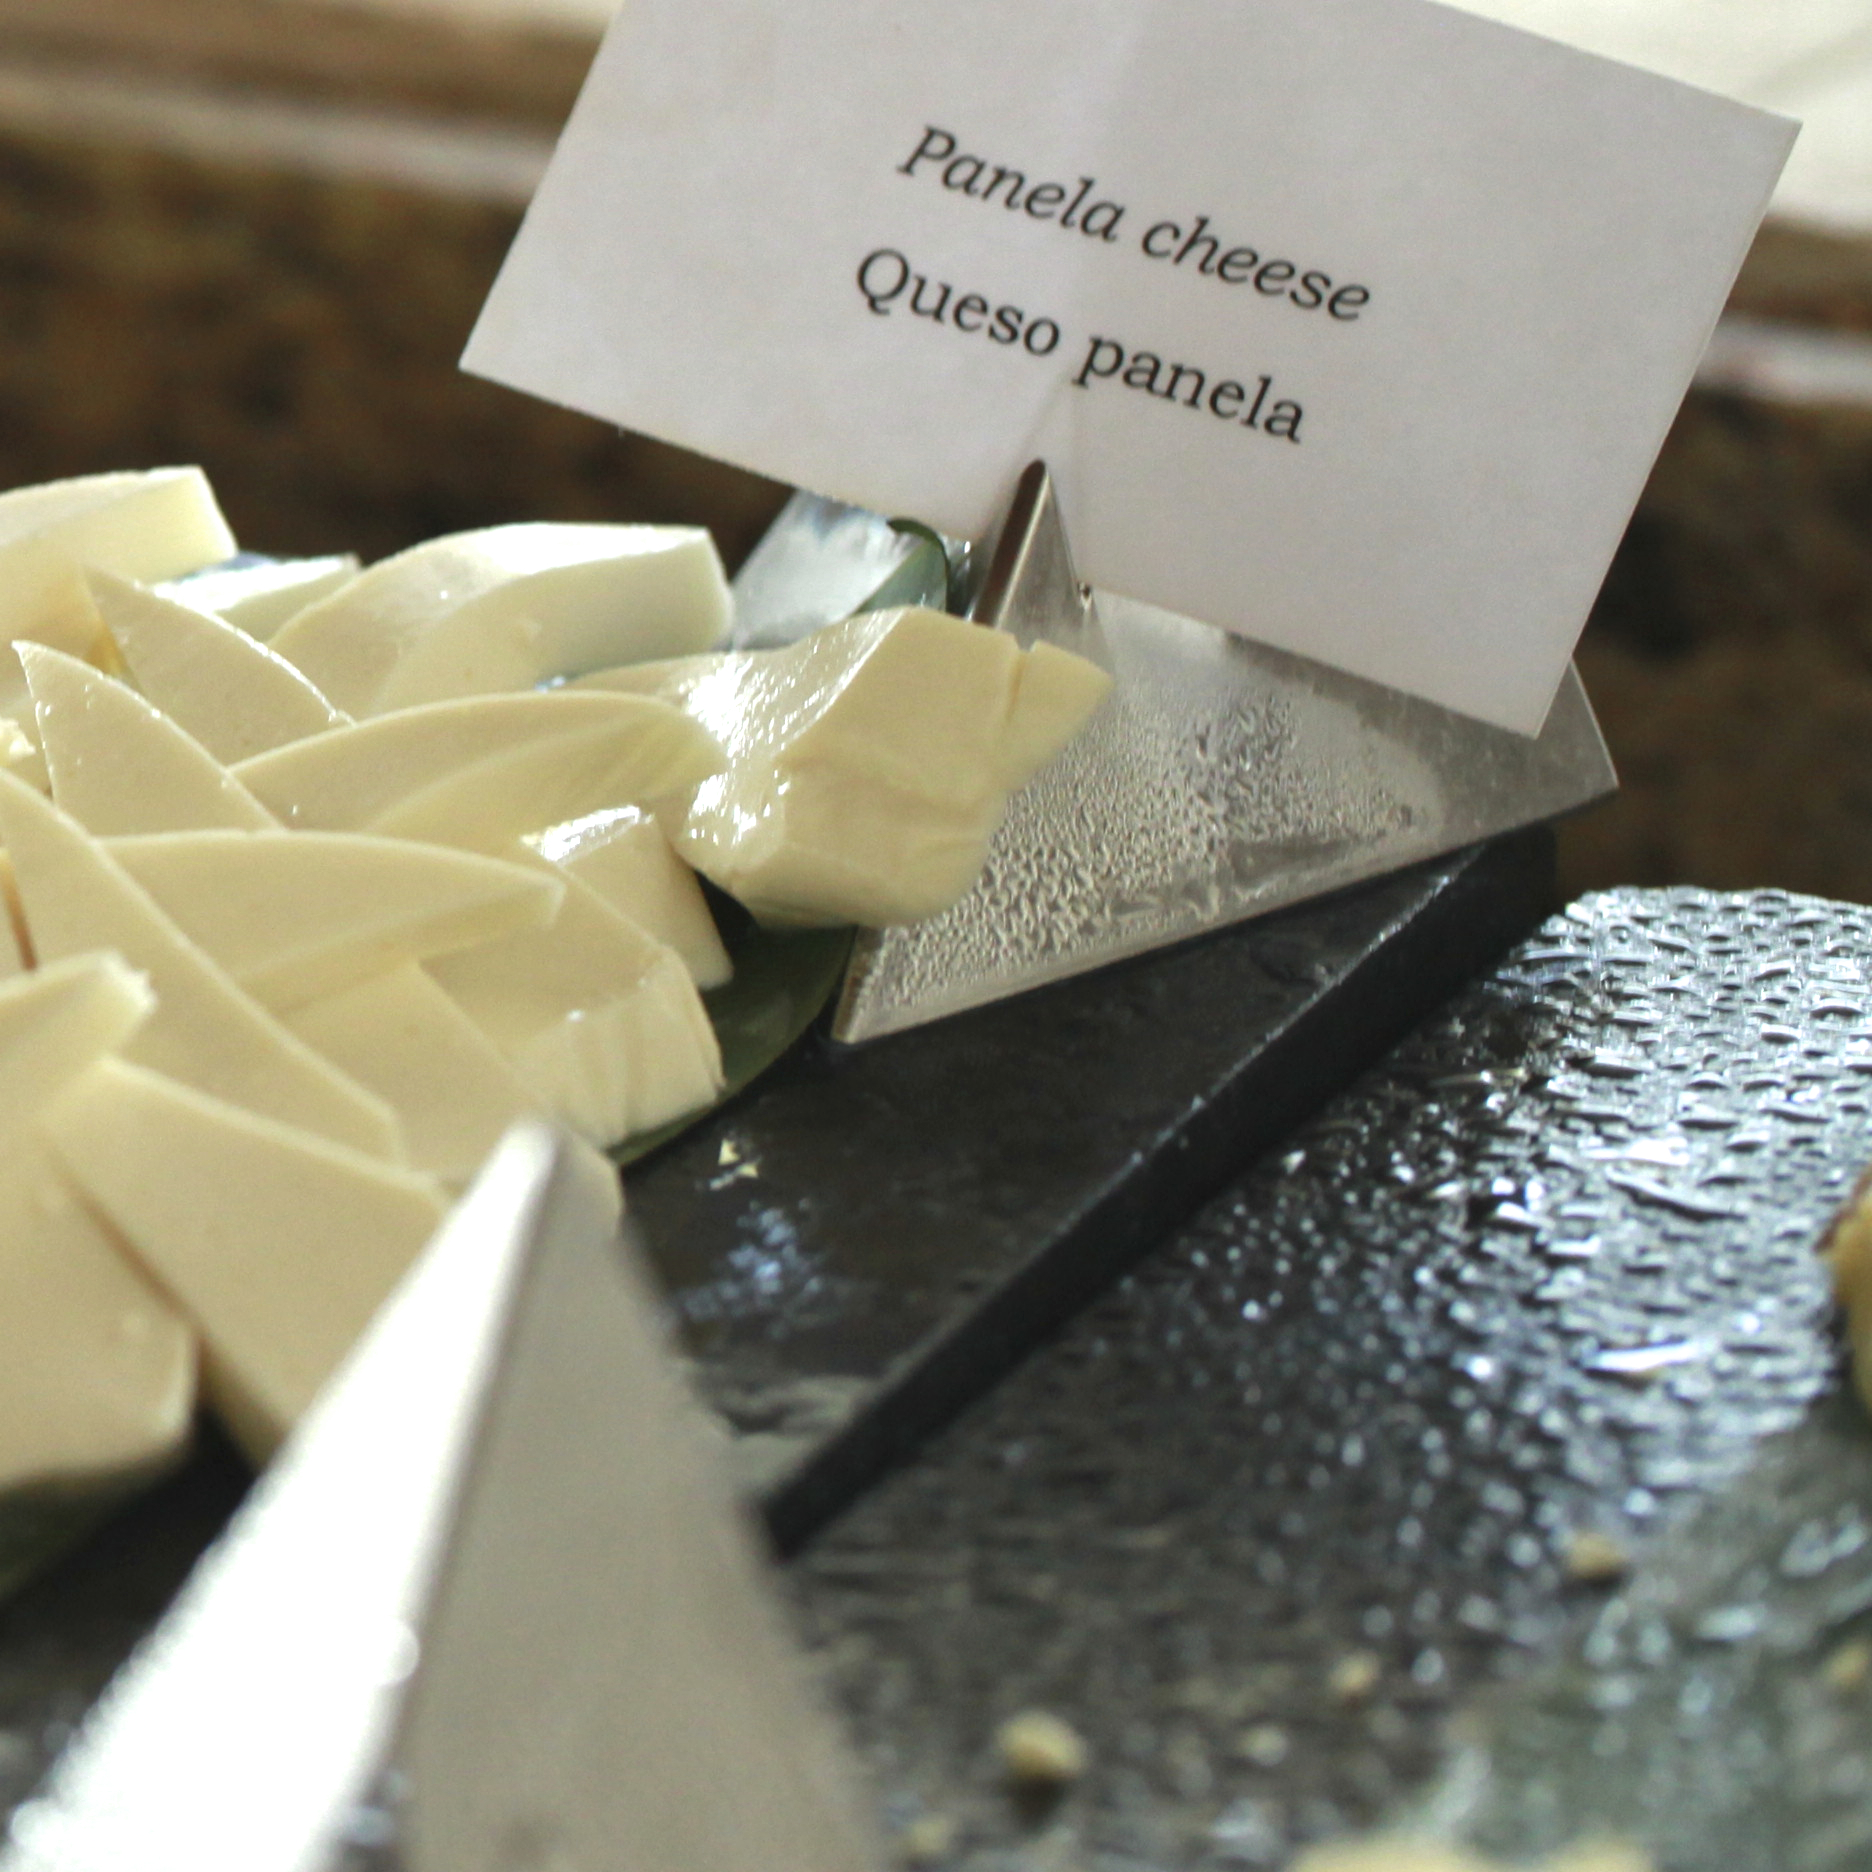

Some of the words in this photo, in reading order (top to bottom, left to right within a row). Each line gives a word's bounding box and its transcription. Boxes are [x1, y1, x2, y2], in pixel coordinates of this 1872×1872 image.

[898, 126, 1126, 243] Panela
[1139, 216, 1371, 322] cheese
[856, 248, 1062, 357] Queso
[1072, 336, 1304, 444] panela
